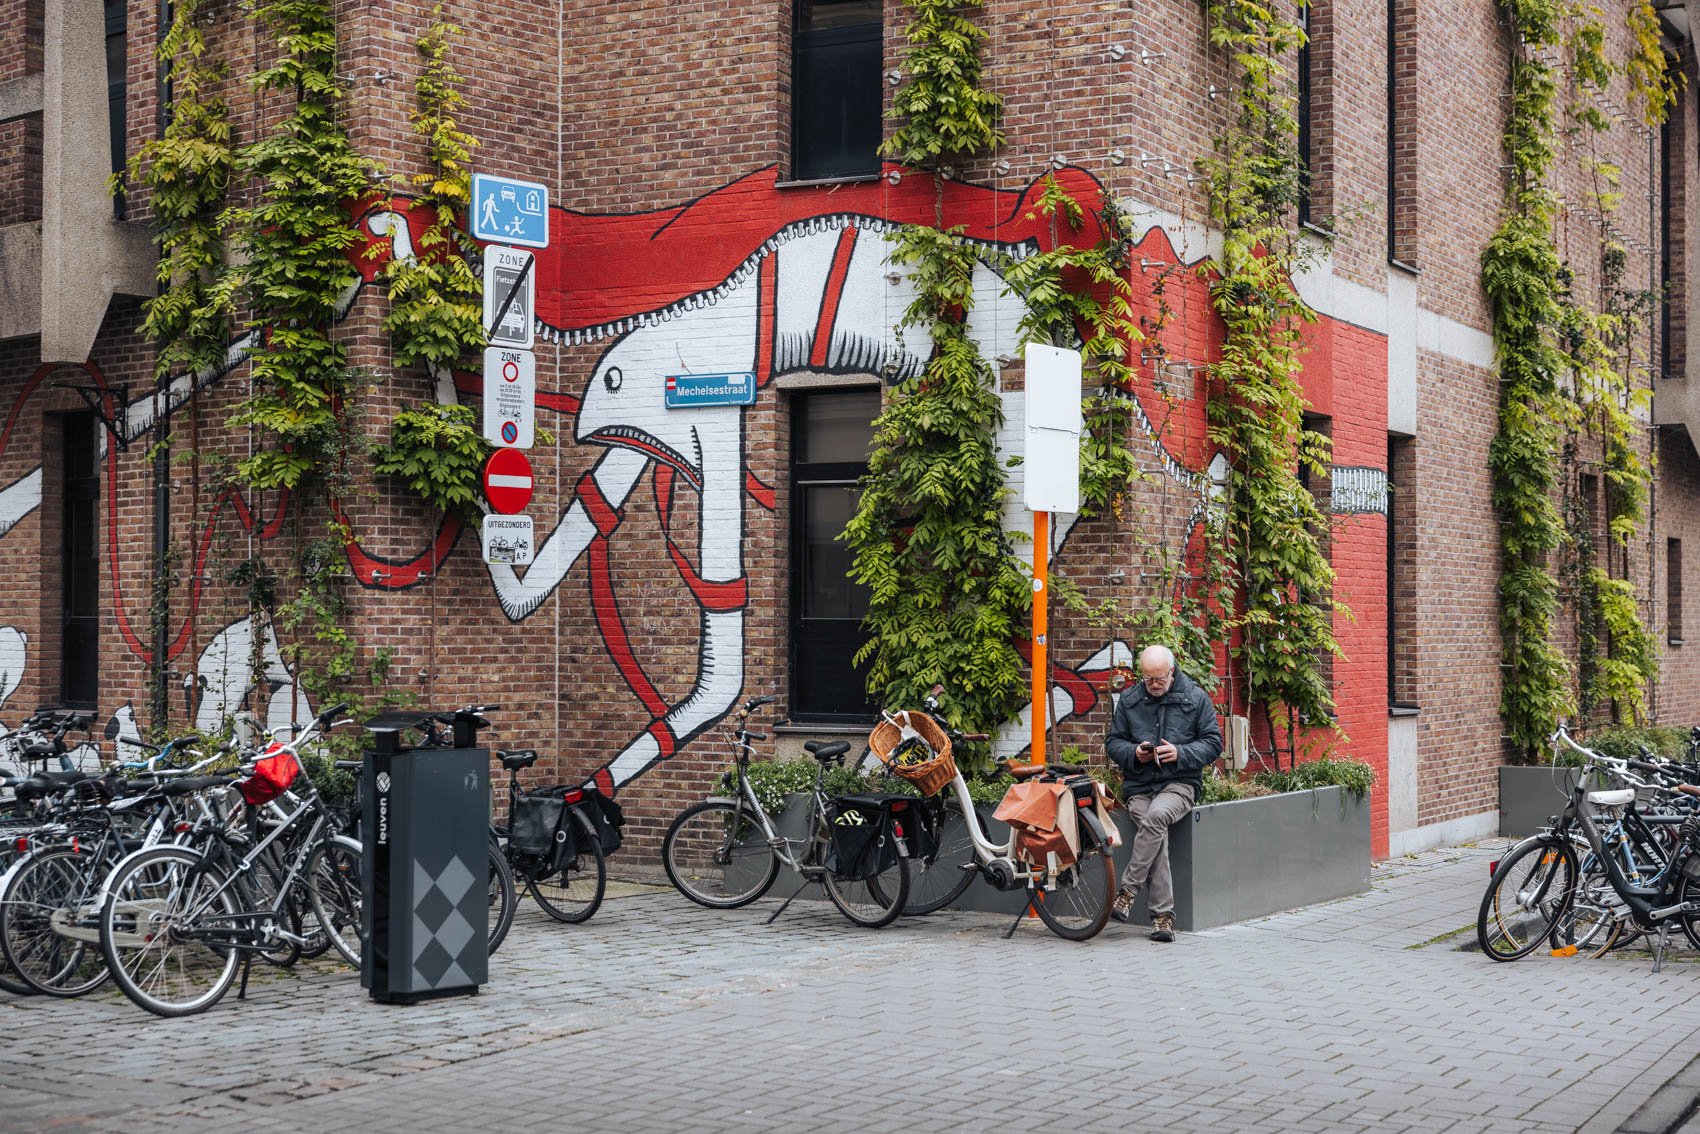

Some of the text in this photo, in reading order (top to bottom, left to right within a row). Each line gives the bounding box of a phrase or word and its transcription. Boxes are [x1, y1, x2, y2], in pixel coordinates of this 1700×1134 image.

[499, 253, 524, 267] ZONE
[501, 351, 521, 363] ZONE
[676, 384, 748, 397] Mechelsestraat
[488, 520, 531, 529] UITGEZONDERD
[377, 797, 387, 845] leuven
